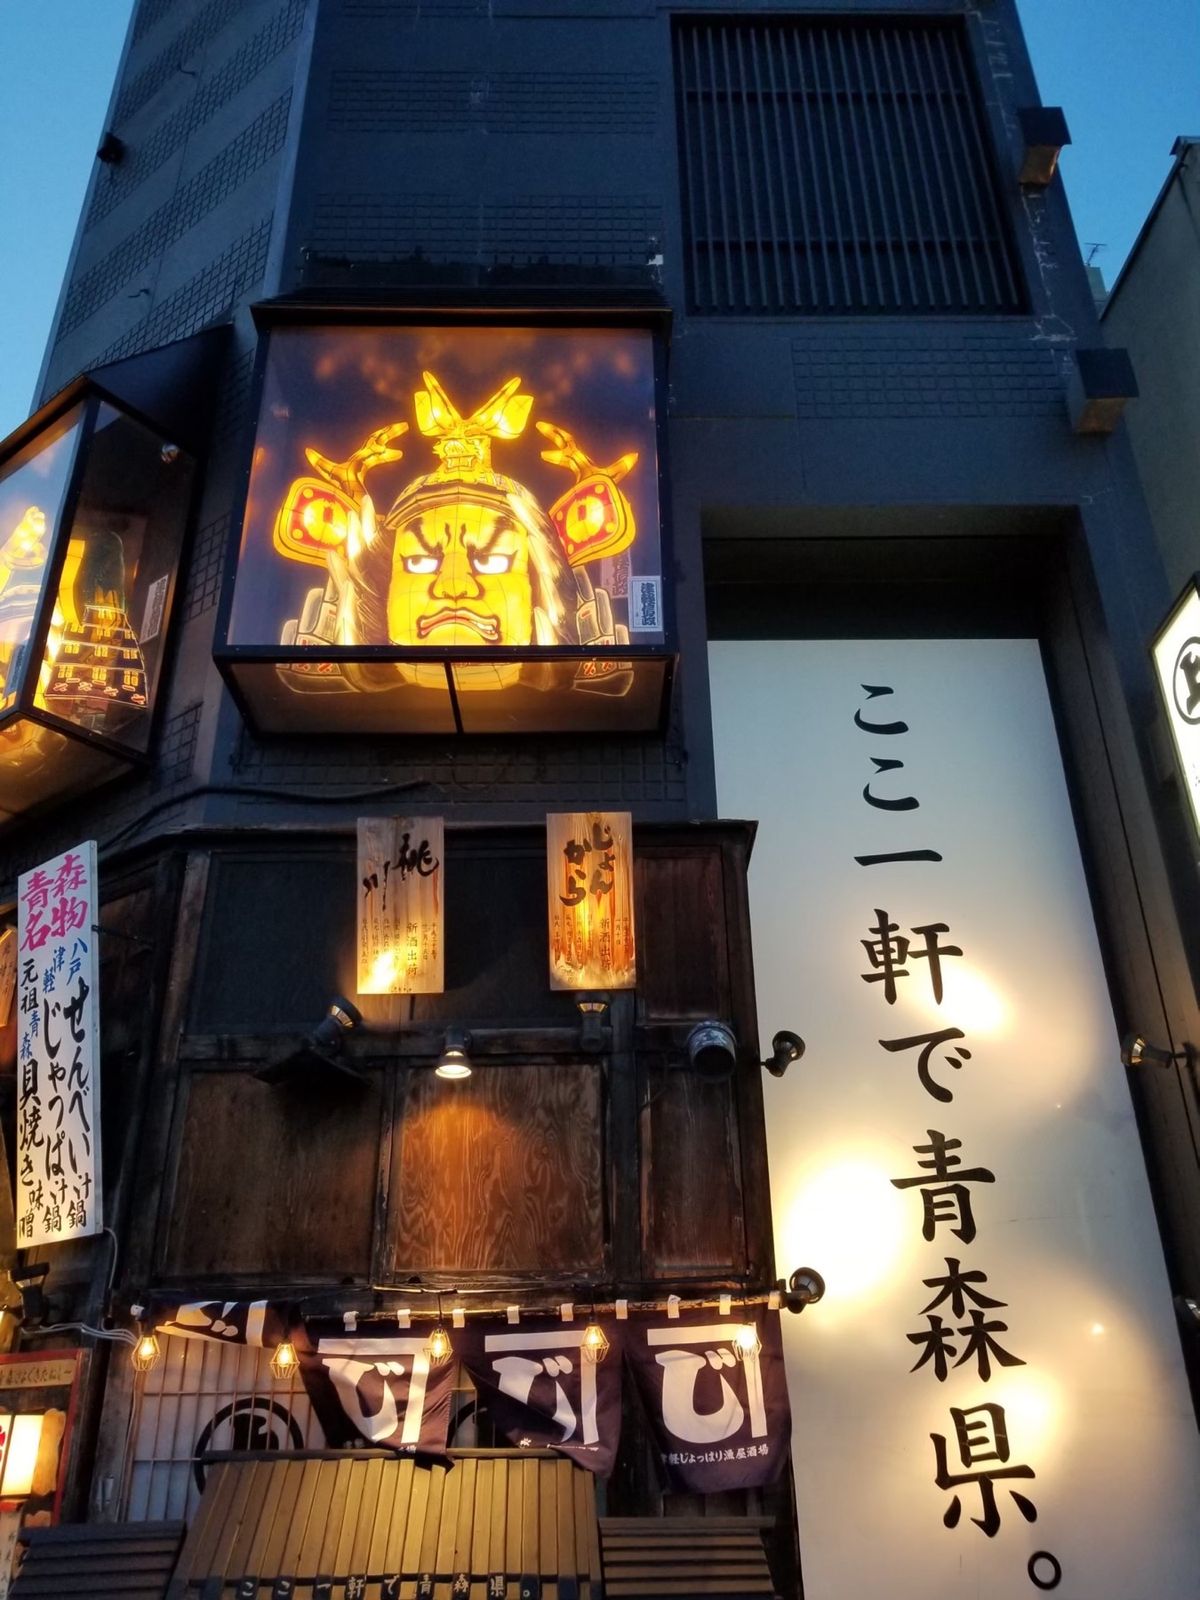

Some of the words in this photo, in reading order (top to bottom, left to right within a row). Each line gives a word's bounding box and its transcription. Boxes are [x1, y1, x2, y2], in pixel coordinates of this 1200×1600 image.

[21, 854, 88, 913] 青森
[20, 896, 89, 953] 名物
[854, 684, 1061, 1590] ここ一軒で青森県。
[241, 1575, 530, 1598] ここ一軒で青森県。
